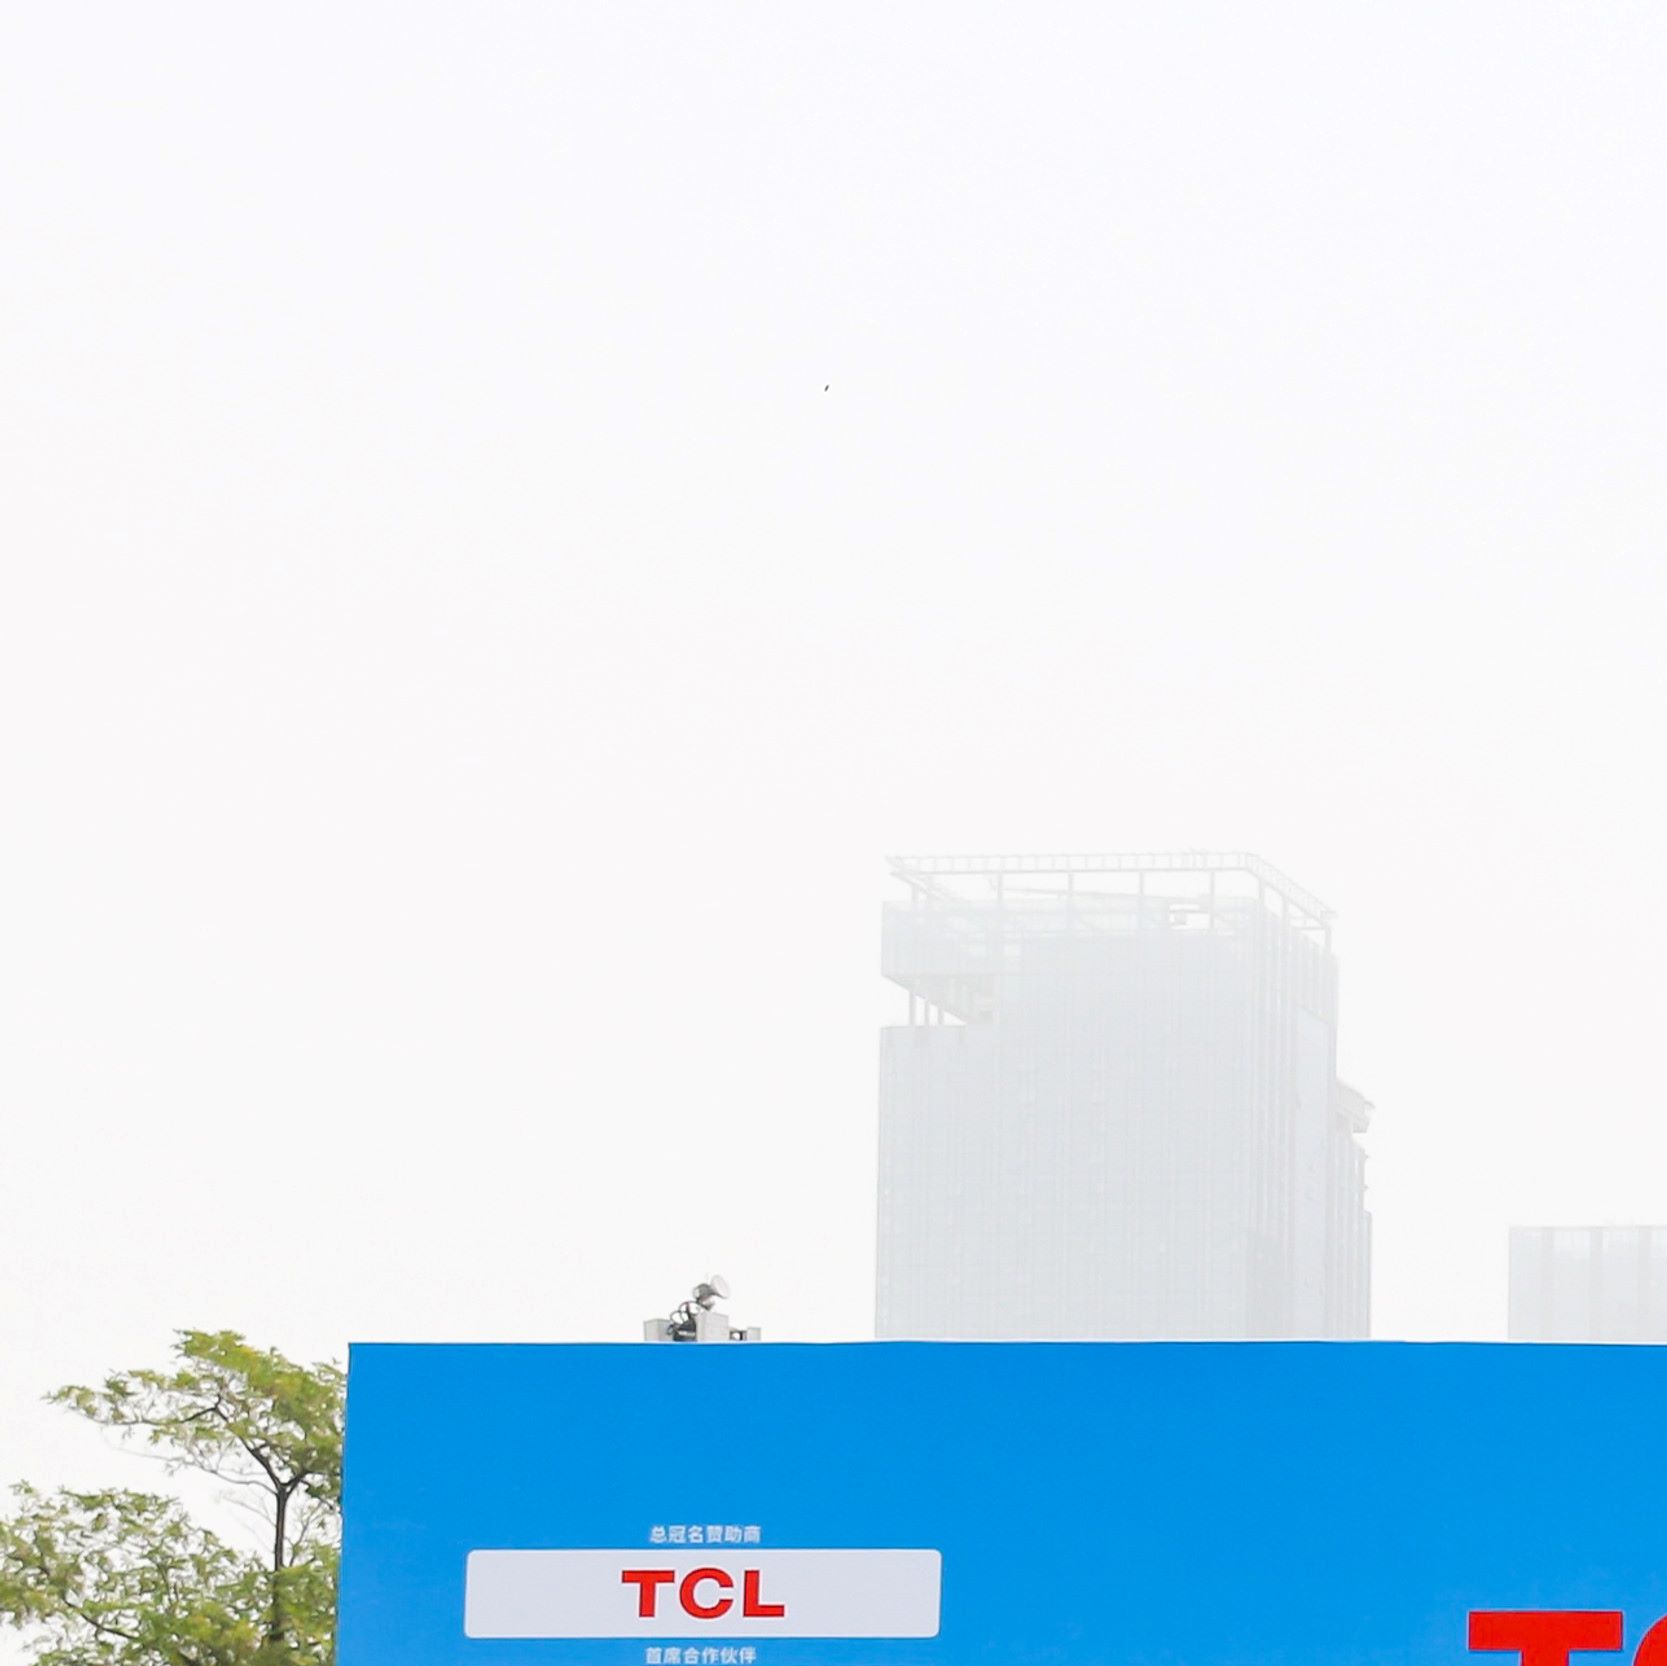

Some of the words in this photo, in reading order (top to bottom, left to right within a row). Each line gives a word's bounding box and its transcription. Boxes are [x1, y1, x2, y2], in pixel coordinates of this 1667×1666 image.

[649, 1526, 761, 1544] 总冠名赞助商
[621, 1567, 786, 1619] TCL
[645, 1647, 757, 1665] 首席合作伙伴
